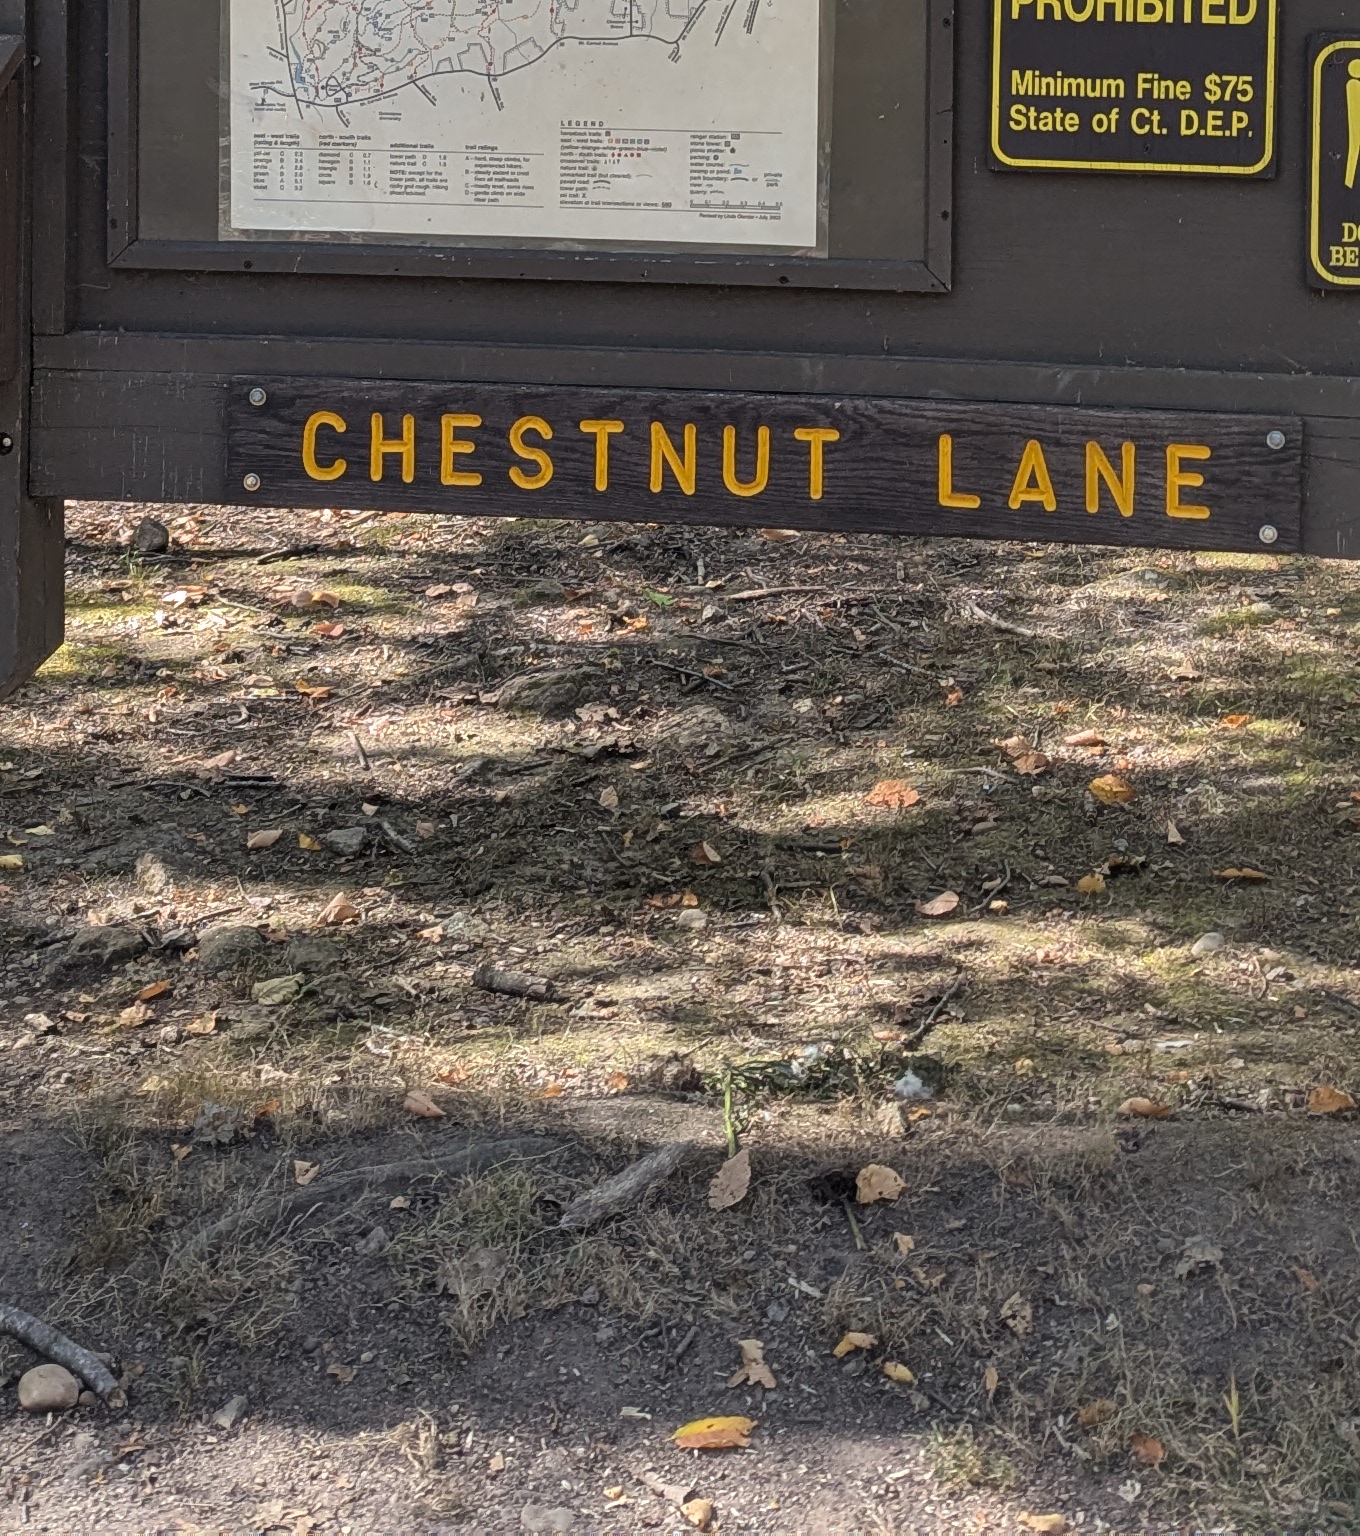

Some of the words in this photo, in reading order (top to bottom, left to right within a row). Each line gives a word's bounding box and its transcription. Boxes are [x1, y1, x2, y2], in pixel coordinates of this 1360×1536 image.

[1011, 70, 1125, 99] Minimum
[1137, 72, 1191, 100] Fine
[1205, 74, 1253, 103] $75
[1009, 105, 1080, 133] State
[1092, 107, 1119, 133] of
[1131, 108, 1168, 135] Ct.
[1180, 110, 1252, 138] D.E.P.
[1329, 246, 1360, 268] BE
[302, 411, 839, 500] CHESTNUT
[938, 433, 1211, 520] LANE
